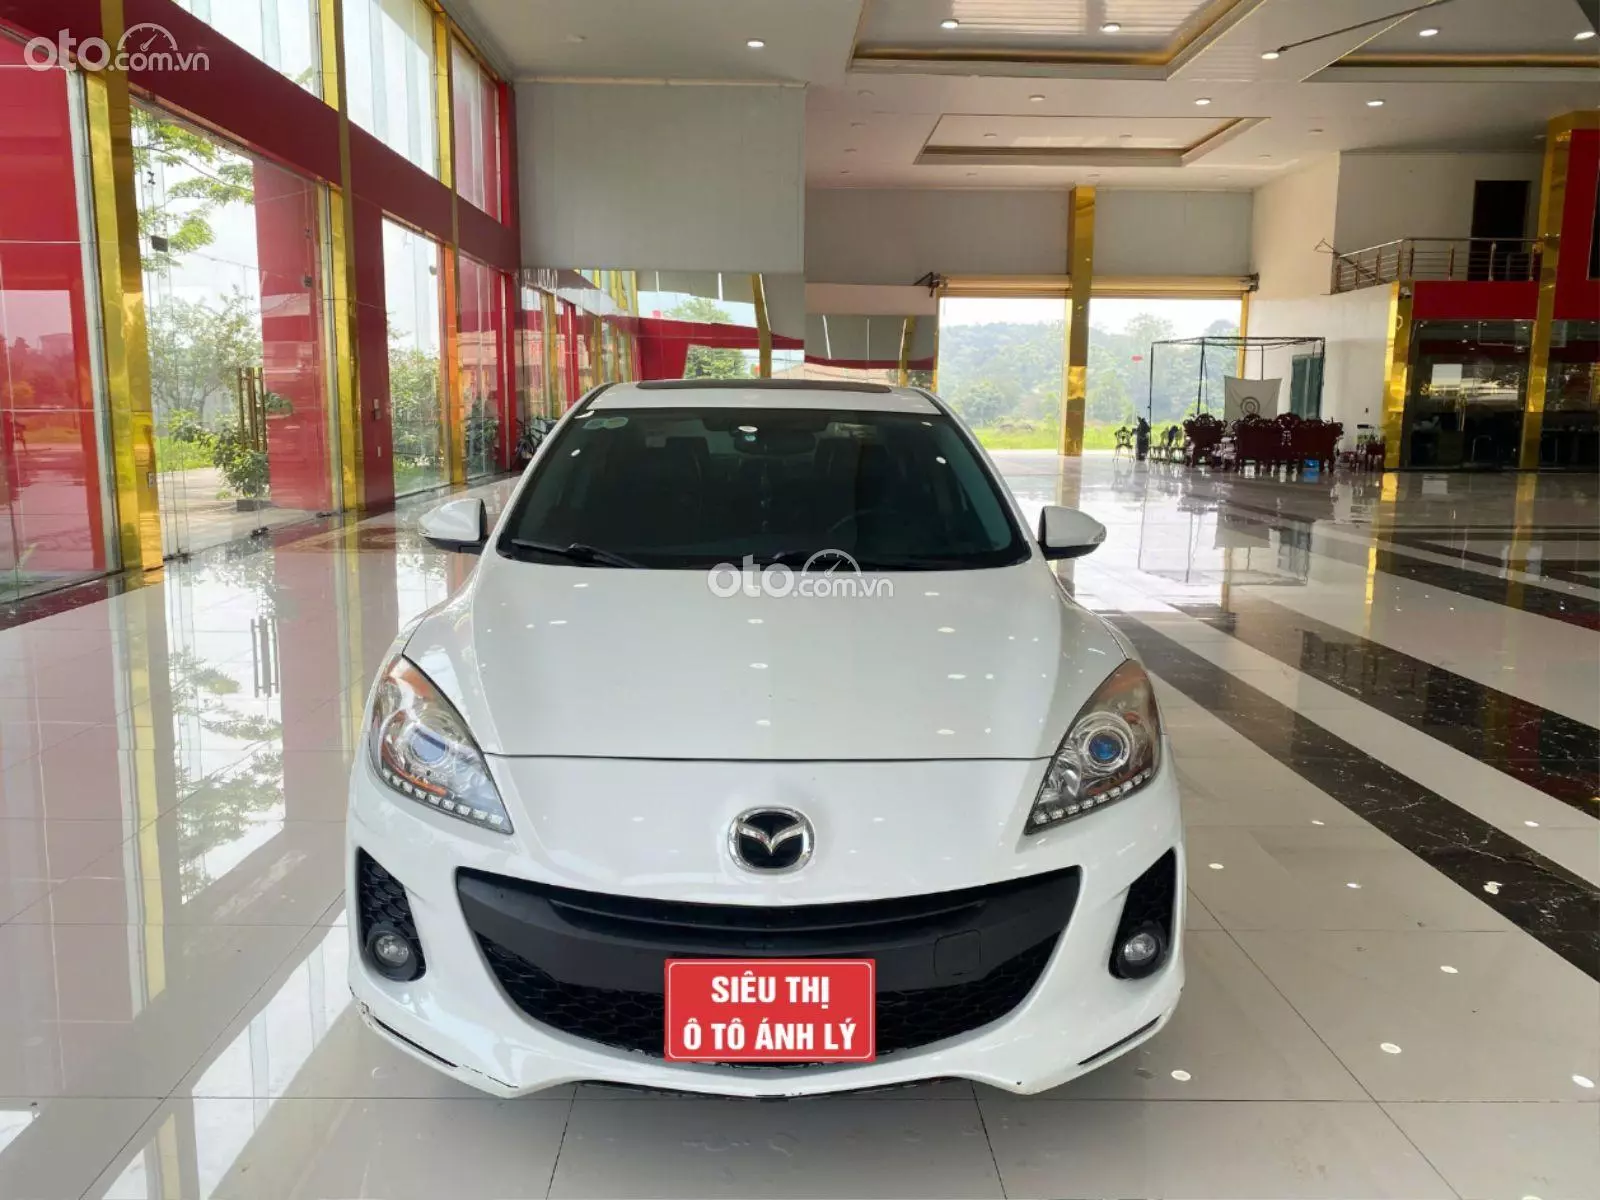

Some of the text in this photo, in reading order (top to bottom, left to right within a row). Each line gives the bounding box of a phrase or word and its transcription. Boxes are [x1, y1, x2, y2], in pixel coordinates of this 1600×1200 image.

[711, 970, 830, 1009] SIÊU THỊ
[683, 1017, 857, 1050] Ô TÔ ÁNH LÝ
